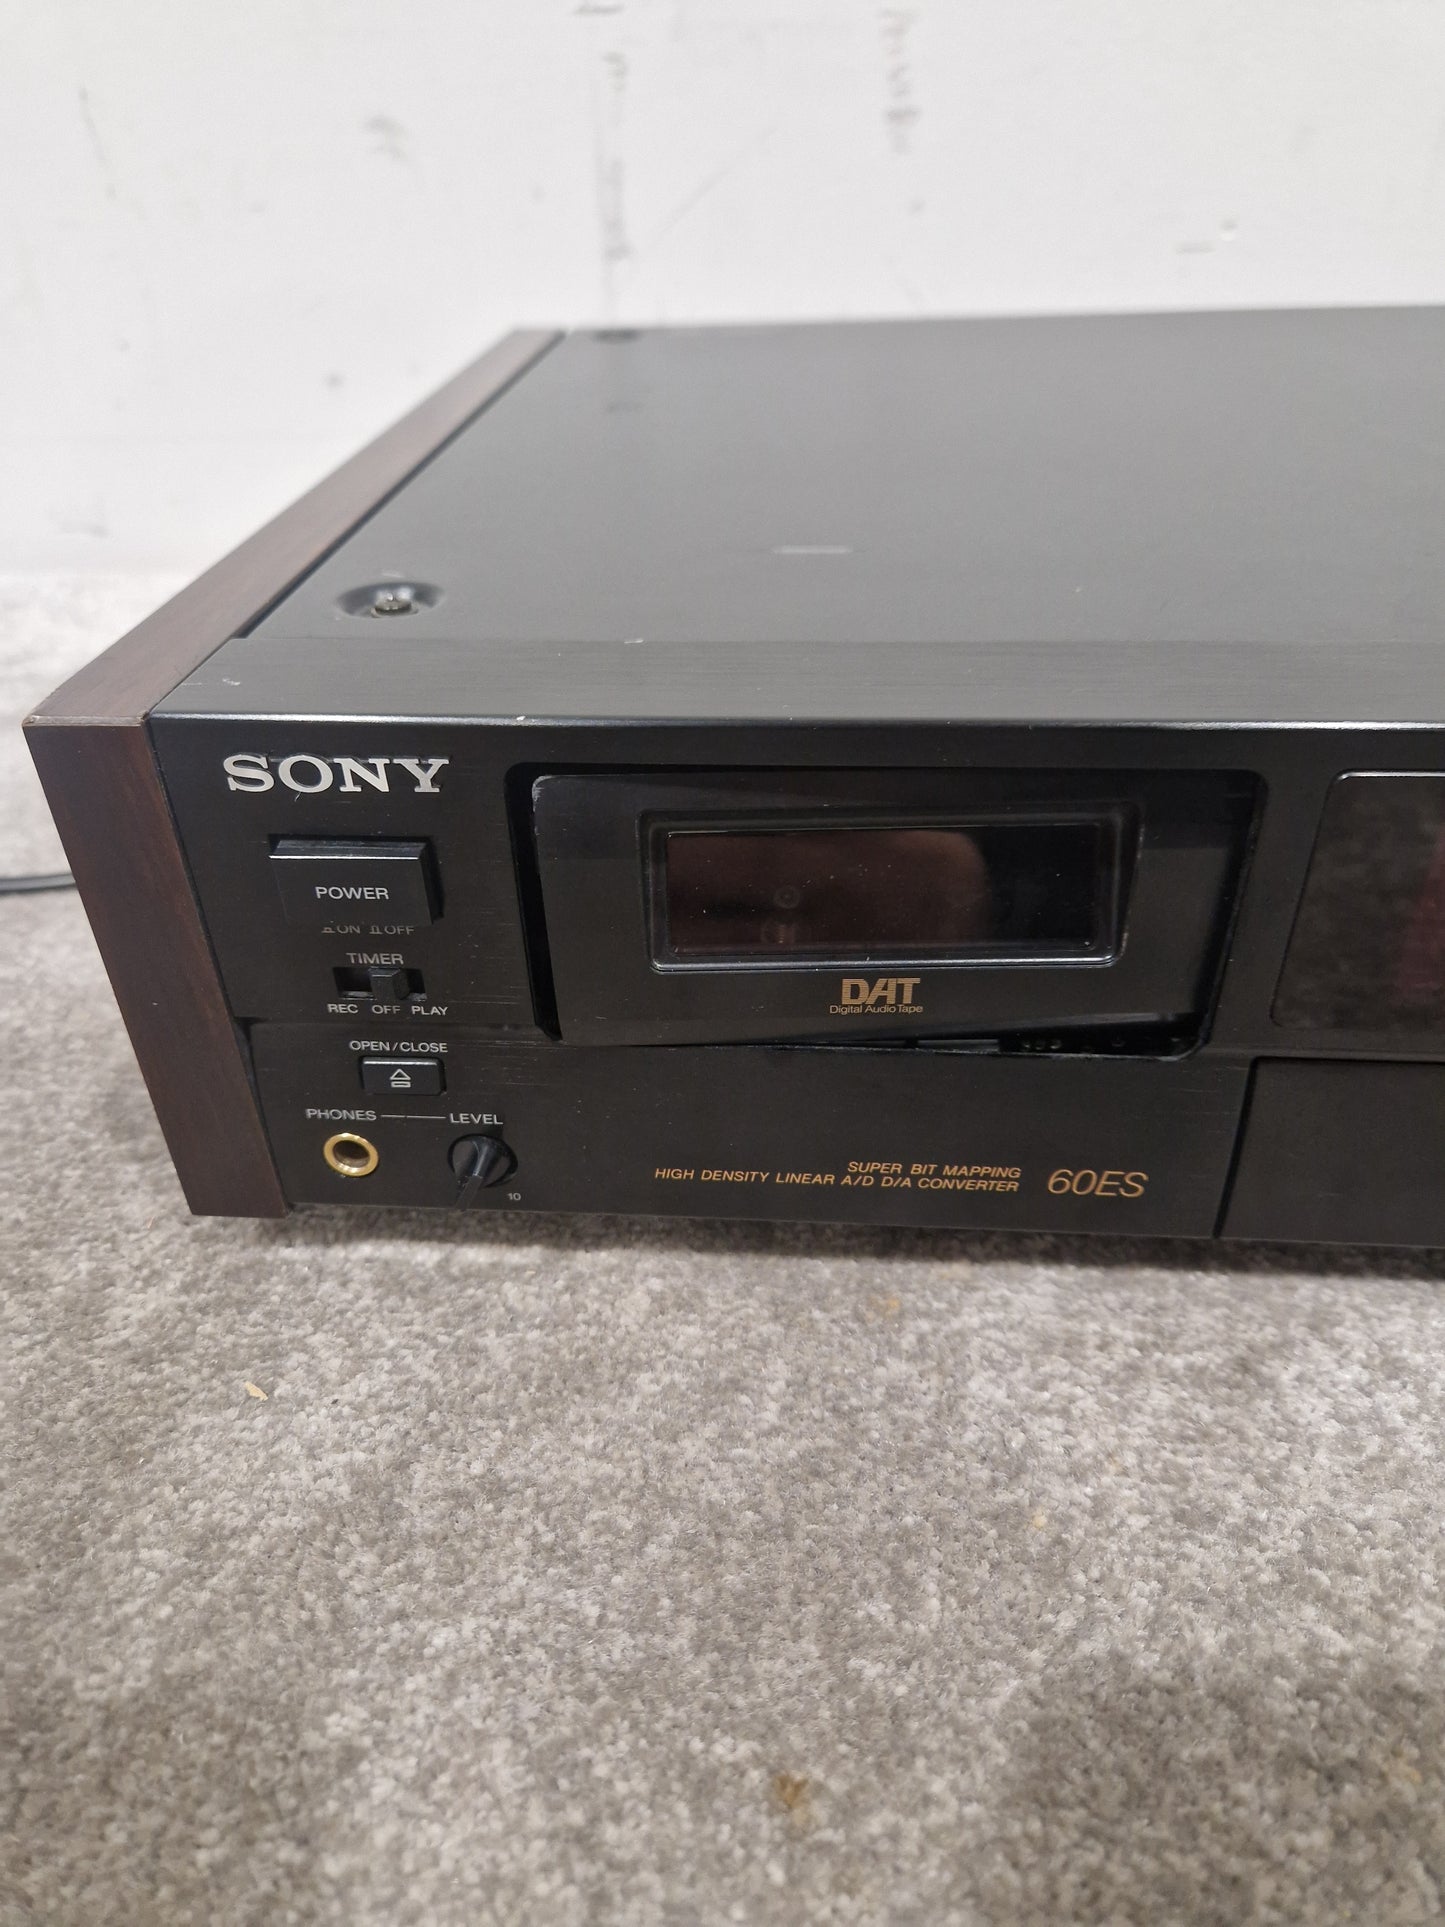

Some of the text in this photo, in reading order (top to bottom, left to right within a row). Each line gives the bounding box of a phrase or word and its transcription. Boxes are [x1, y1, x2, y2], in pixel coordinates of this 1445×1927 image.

[223, 754, 449, 793] SONY
[314, 886, 389, 900] POWER
[337, 925, 415, 935] ON OFF
[346, 952, 404, 965] TIMER
[841, 978, 921, 1005] DAT
[327, 1003, 448, 1016] REC OFF PLAY
[829, 1004, 923, 1016] Digital Audio Tape
[305, 1108, 503, 1125] PHONES LEVEL
[848, 1161, 1022, 1179] SUPER BIT MAPPING
[655, 1167, 1020, 1192] HIGH DENSITY LINEAR A/D D/A CONVERTER
[1047, 1168, 1149, 1198] 60ES
[508, 1192, 522, 1202] 10
